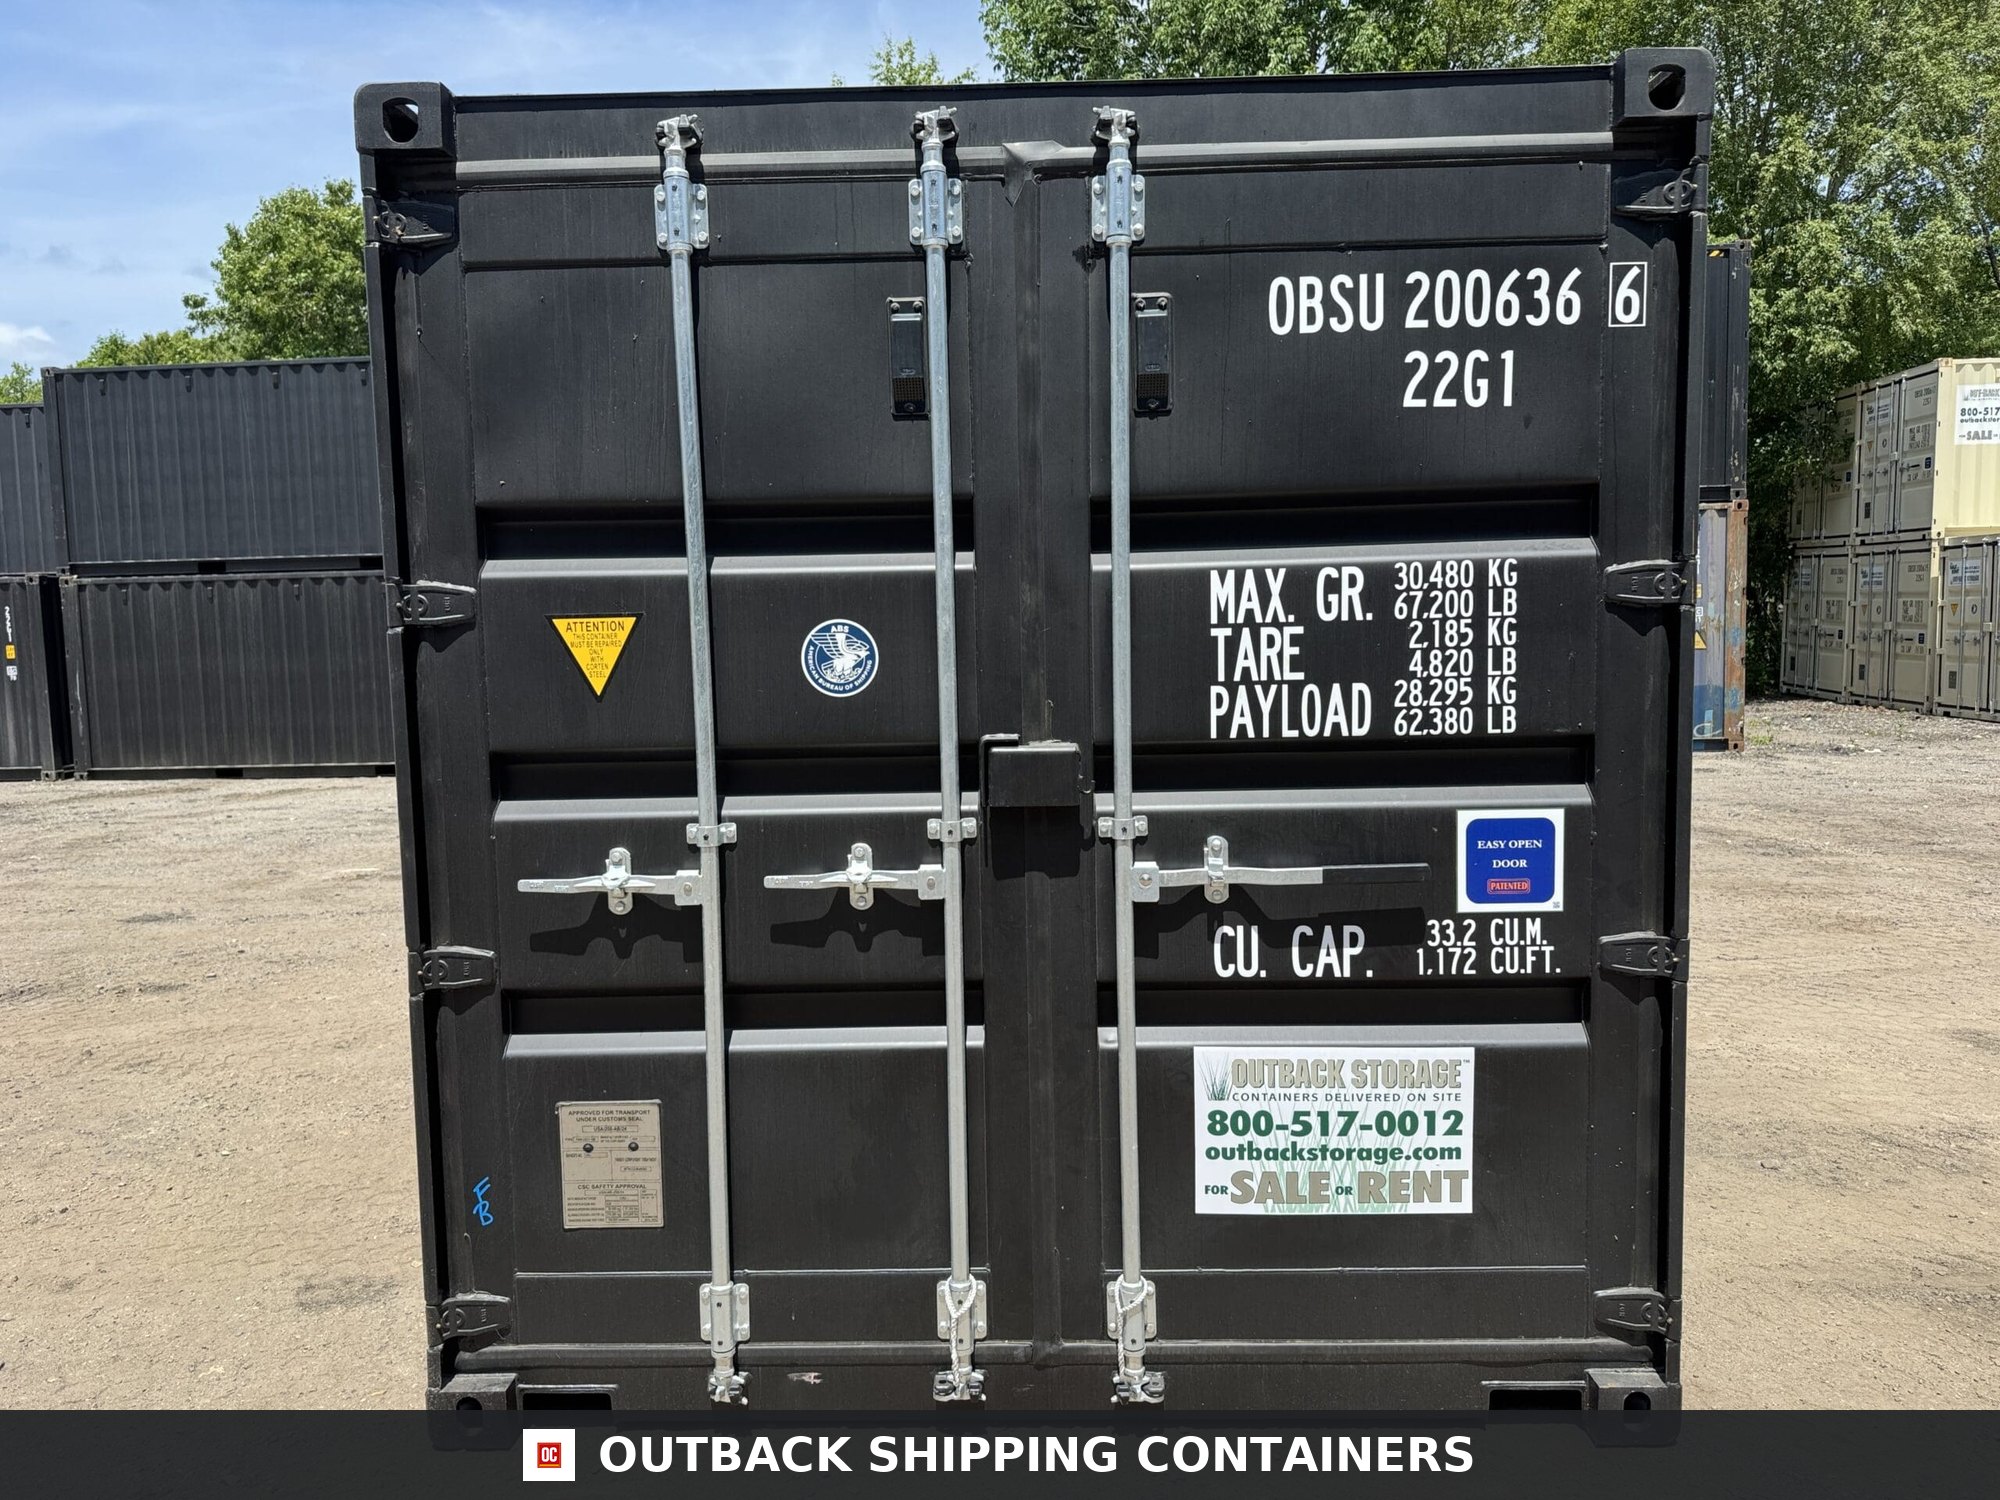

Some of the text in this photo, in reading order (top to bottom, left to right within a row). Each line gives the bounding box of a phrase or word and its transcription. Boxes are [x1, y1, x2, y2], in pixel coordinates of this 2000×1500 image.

[1268, 265, 1641, 336] OBSU 200636 6
[1402, 349, 1514, 409] 22G1
[1966, 430, 1993, 441] SALE
[1210, 558, 1518, 625] MAX. GR. 30,480 KG
[1394, 588, 1517, 620] 67,200 LB
[565, 620, 625, 633] ATTENTION
[573, 632, 618, 641] THIS CONTAINER
[831, 624, 850, 633] ABS
[570, 640, 623, 649] MUST BE REPAIRED
[589, 648, 604, 656] ONLY
[1210, 617, 1517, 682] TARE 2,185 KG
[586, 663, 609, 671] CORTEN
[589, 671, 607, 679] STEEL
[807, 645, 819, 680] AMERICAN
[818, 678, 843, 691] BUREAU
[854, 659, 873, 687] SHIPPING
[1408, 647, 1517, 678] 4,820 LB
[1210, 676, 1517, 739] PAYLOAD 28,295 KG
[1394, 705, 1517, 736] 62,380 LB
[1477, 839, 1543, 849] EASY OPEN
[1492, 859, 1528, 868] DOOR
[1490, 881, 1528, 891] PATENTED
[1213, 918, 1547, 978] CU. CAP. 33.2 CU.M.
[1416, 945, 1562, 975] 1,172 CU.FT.
[1231, 1058, 1347, 1090] OUTBACK
[1232, 1092, 1462, 1102] CONTAINERS DELIVERED ON SITE
[1206, 1109, 1464, 1137] 800-517-0012
[1205, 1141, 1462, 1165] outbackstorage.com
[1204, 1170, 1469, 1205] FOR SALE OR RENT
